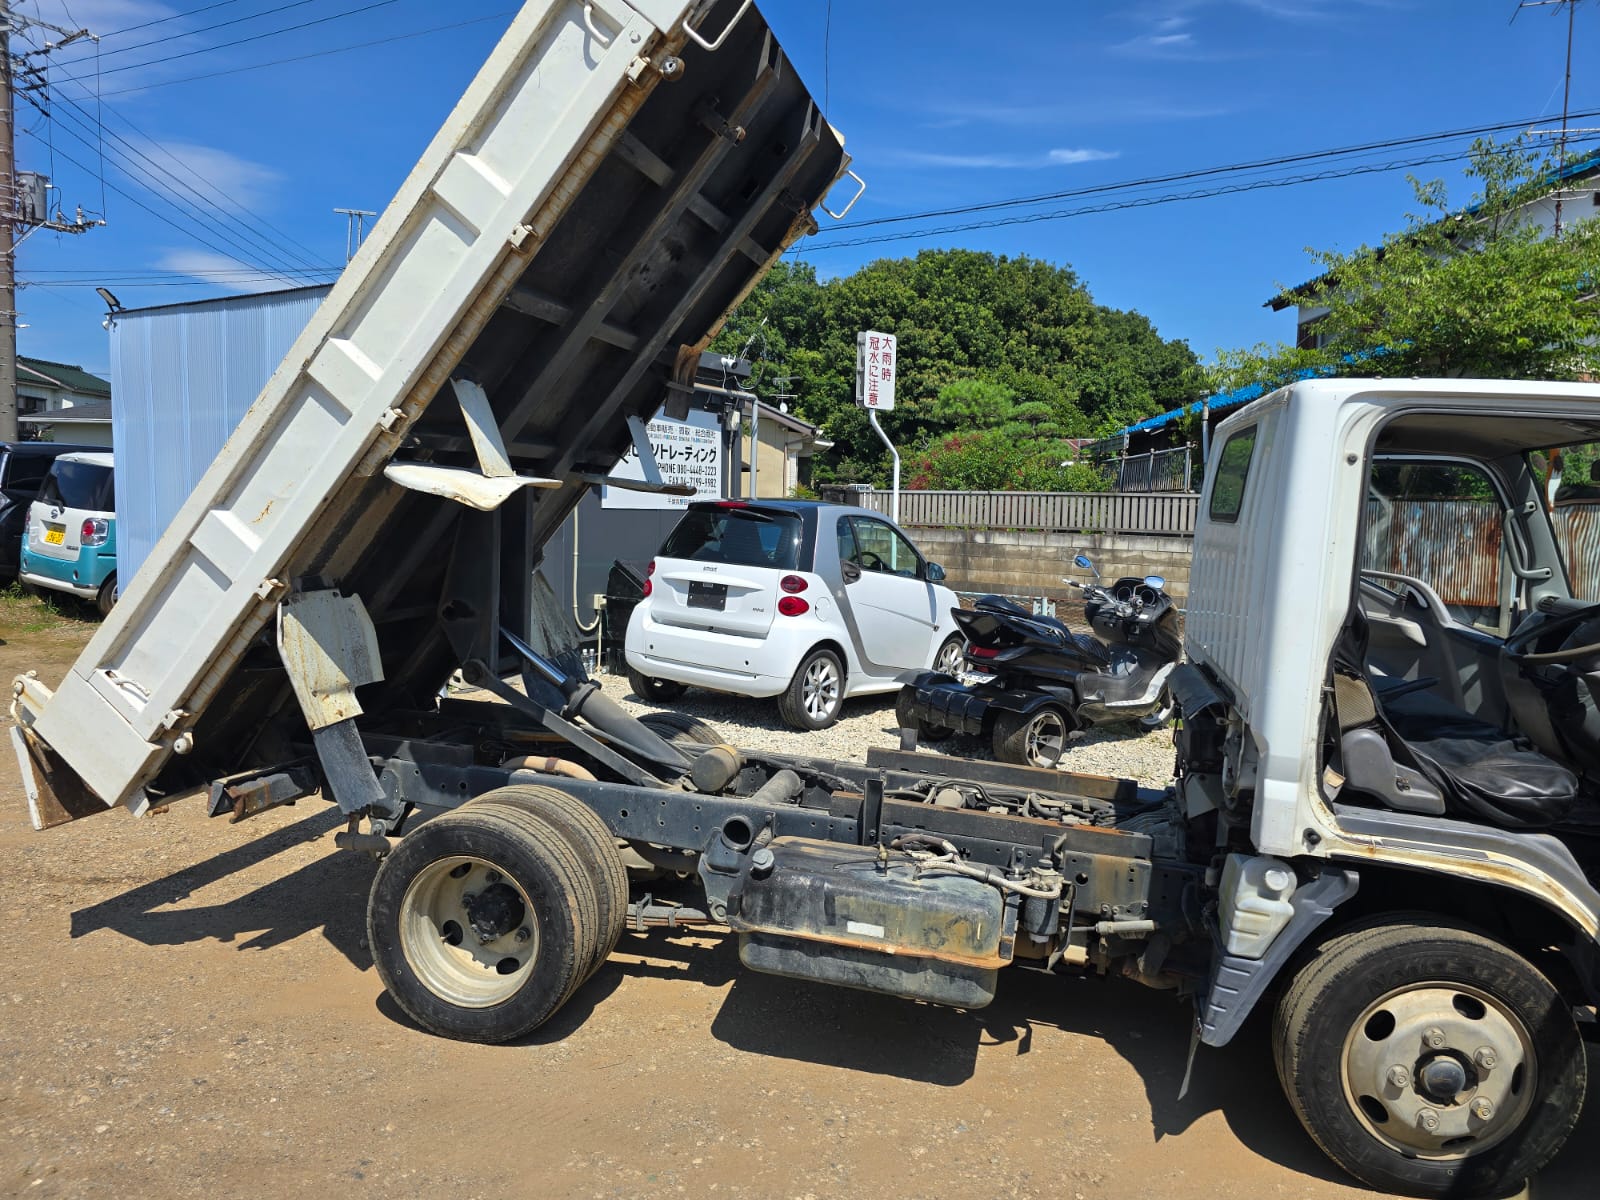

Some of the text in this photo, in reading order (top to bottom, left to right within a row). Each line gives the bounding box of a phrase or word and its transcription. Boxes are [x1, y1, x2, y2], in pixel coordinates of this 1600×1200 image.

[868, 336, 879, 406] 冠水に注意
[881, 336, 892, 381] 大雨時
